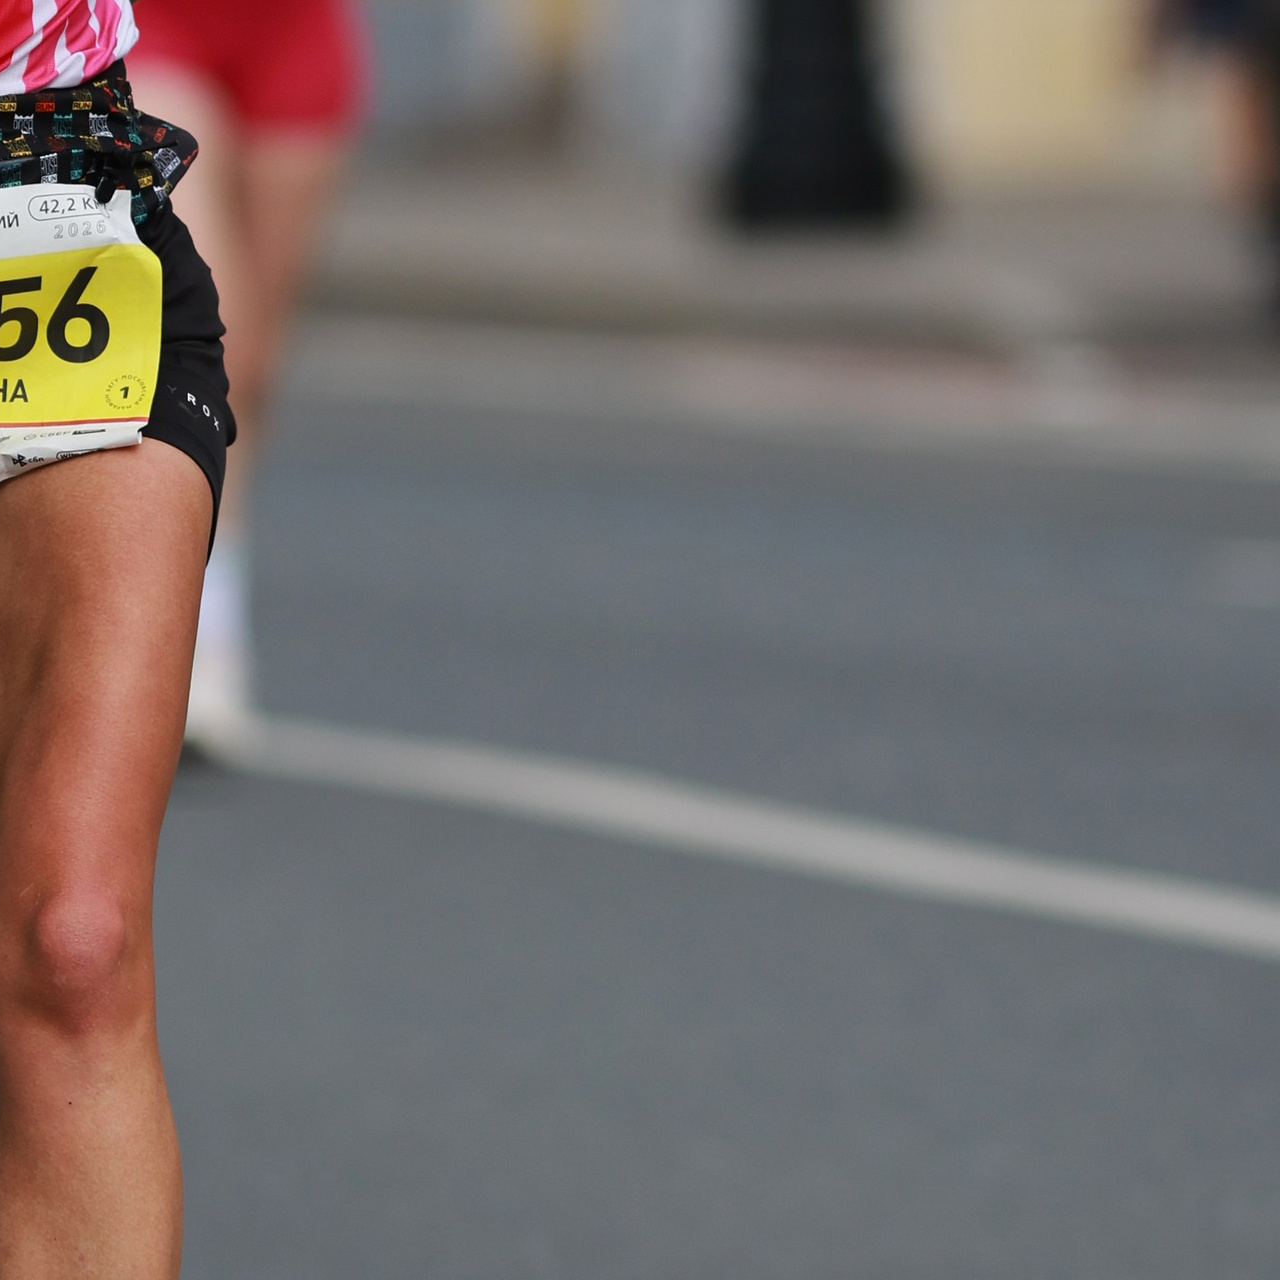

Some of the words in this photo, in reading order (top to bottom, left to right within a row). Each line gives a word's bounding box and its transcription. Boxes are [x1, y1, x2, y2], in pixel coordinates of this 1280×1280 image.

[35, 102, 55, 112] RUN
[72, 101, 92, 111] RUN
[40, 174, 58, 183] RUN
[39, 197, 76, 215] 42,2
[53, 220, 107, 240] 2026
[119, 386, 130, 399] 1
